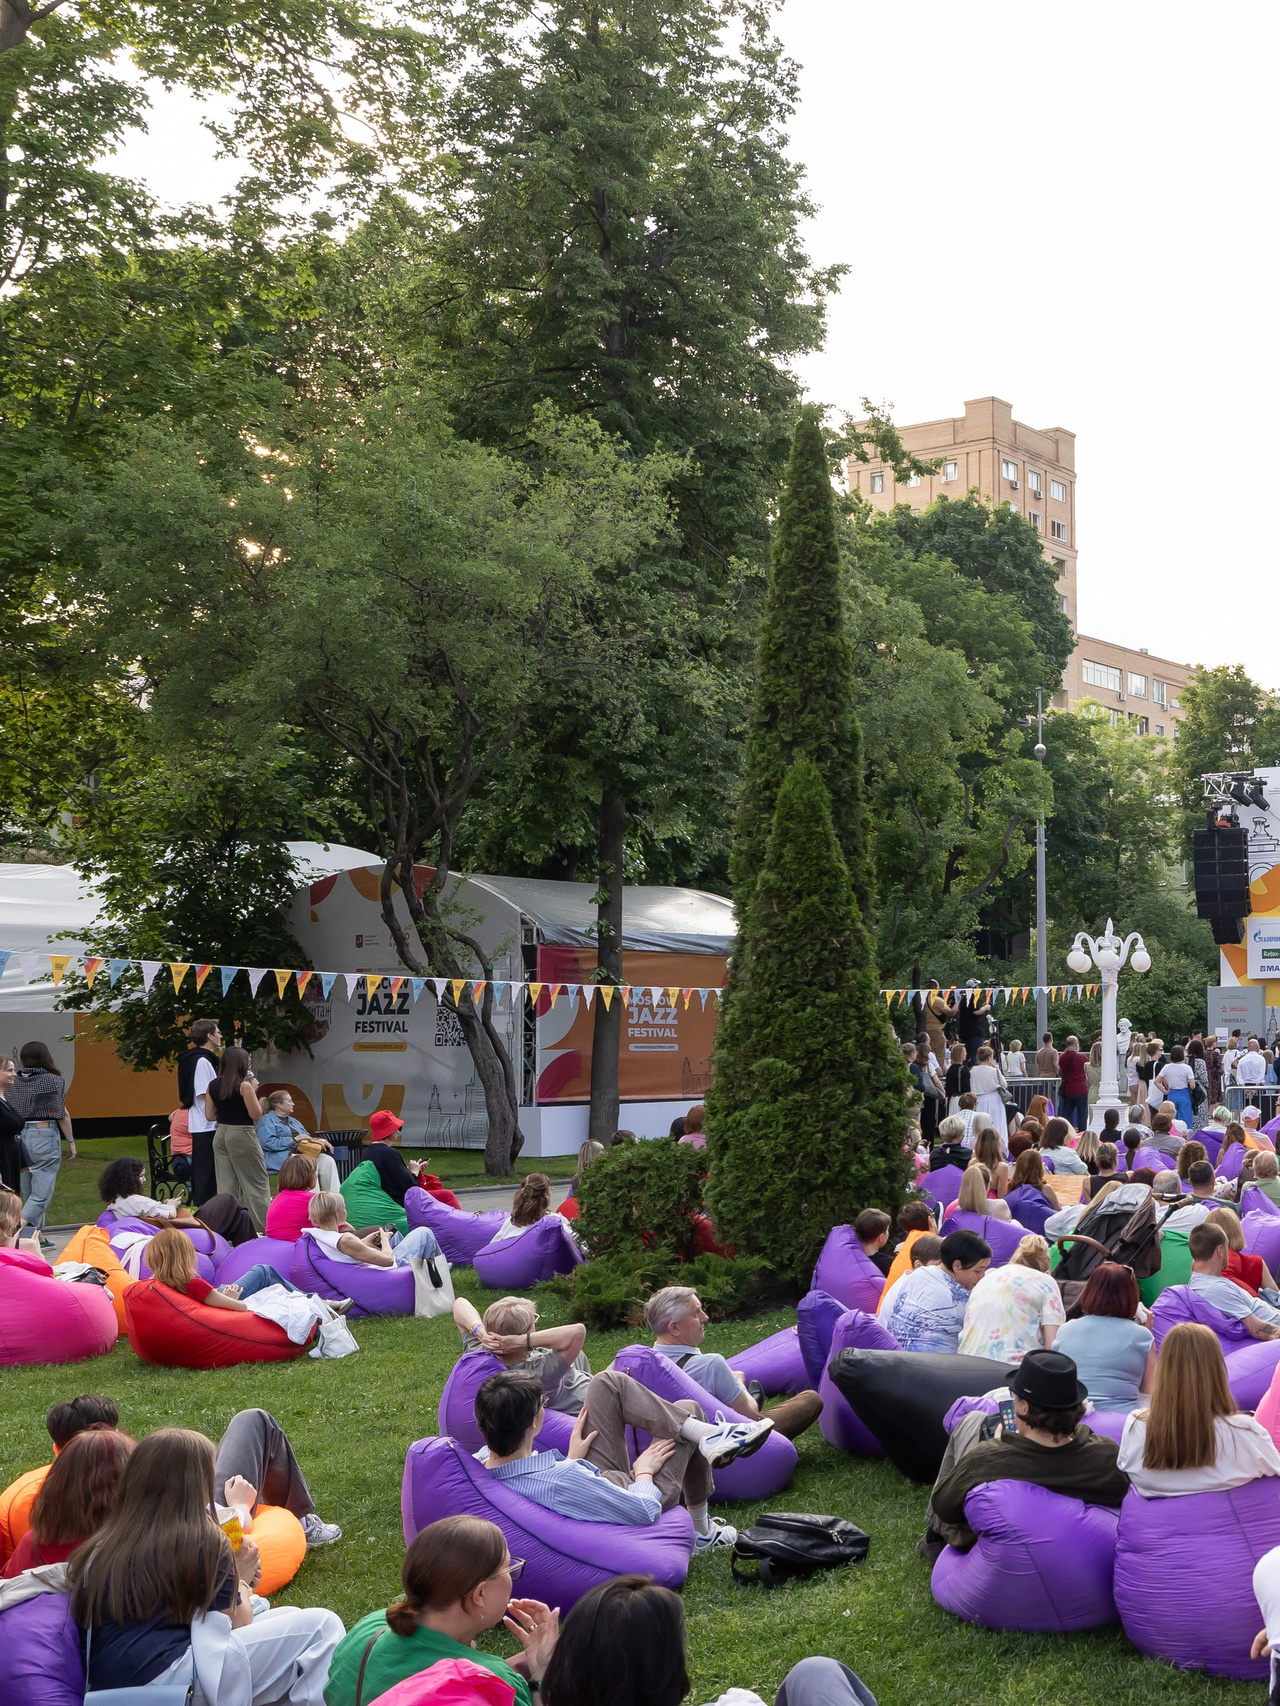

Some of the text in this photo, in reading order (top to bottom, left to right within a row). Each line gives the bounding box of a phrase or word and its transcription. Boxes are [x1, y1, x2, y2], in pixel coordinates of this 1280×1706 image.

[356, 977, 410, 990] MCW
[356, 992, 410, 1016] JAZZ
[628, 1007, 678, 1025] JAZZ
[354, 1020, 409, 1034] FESTIVAL
[627, 1028, 678, 1038] FESTIVAL
